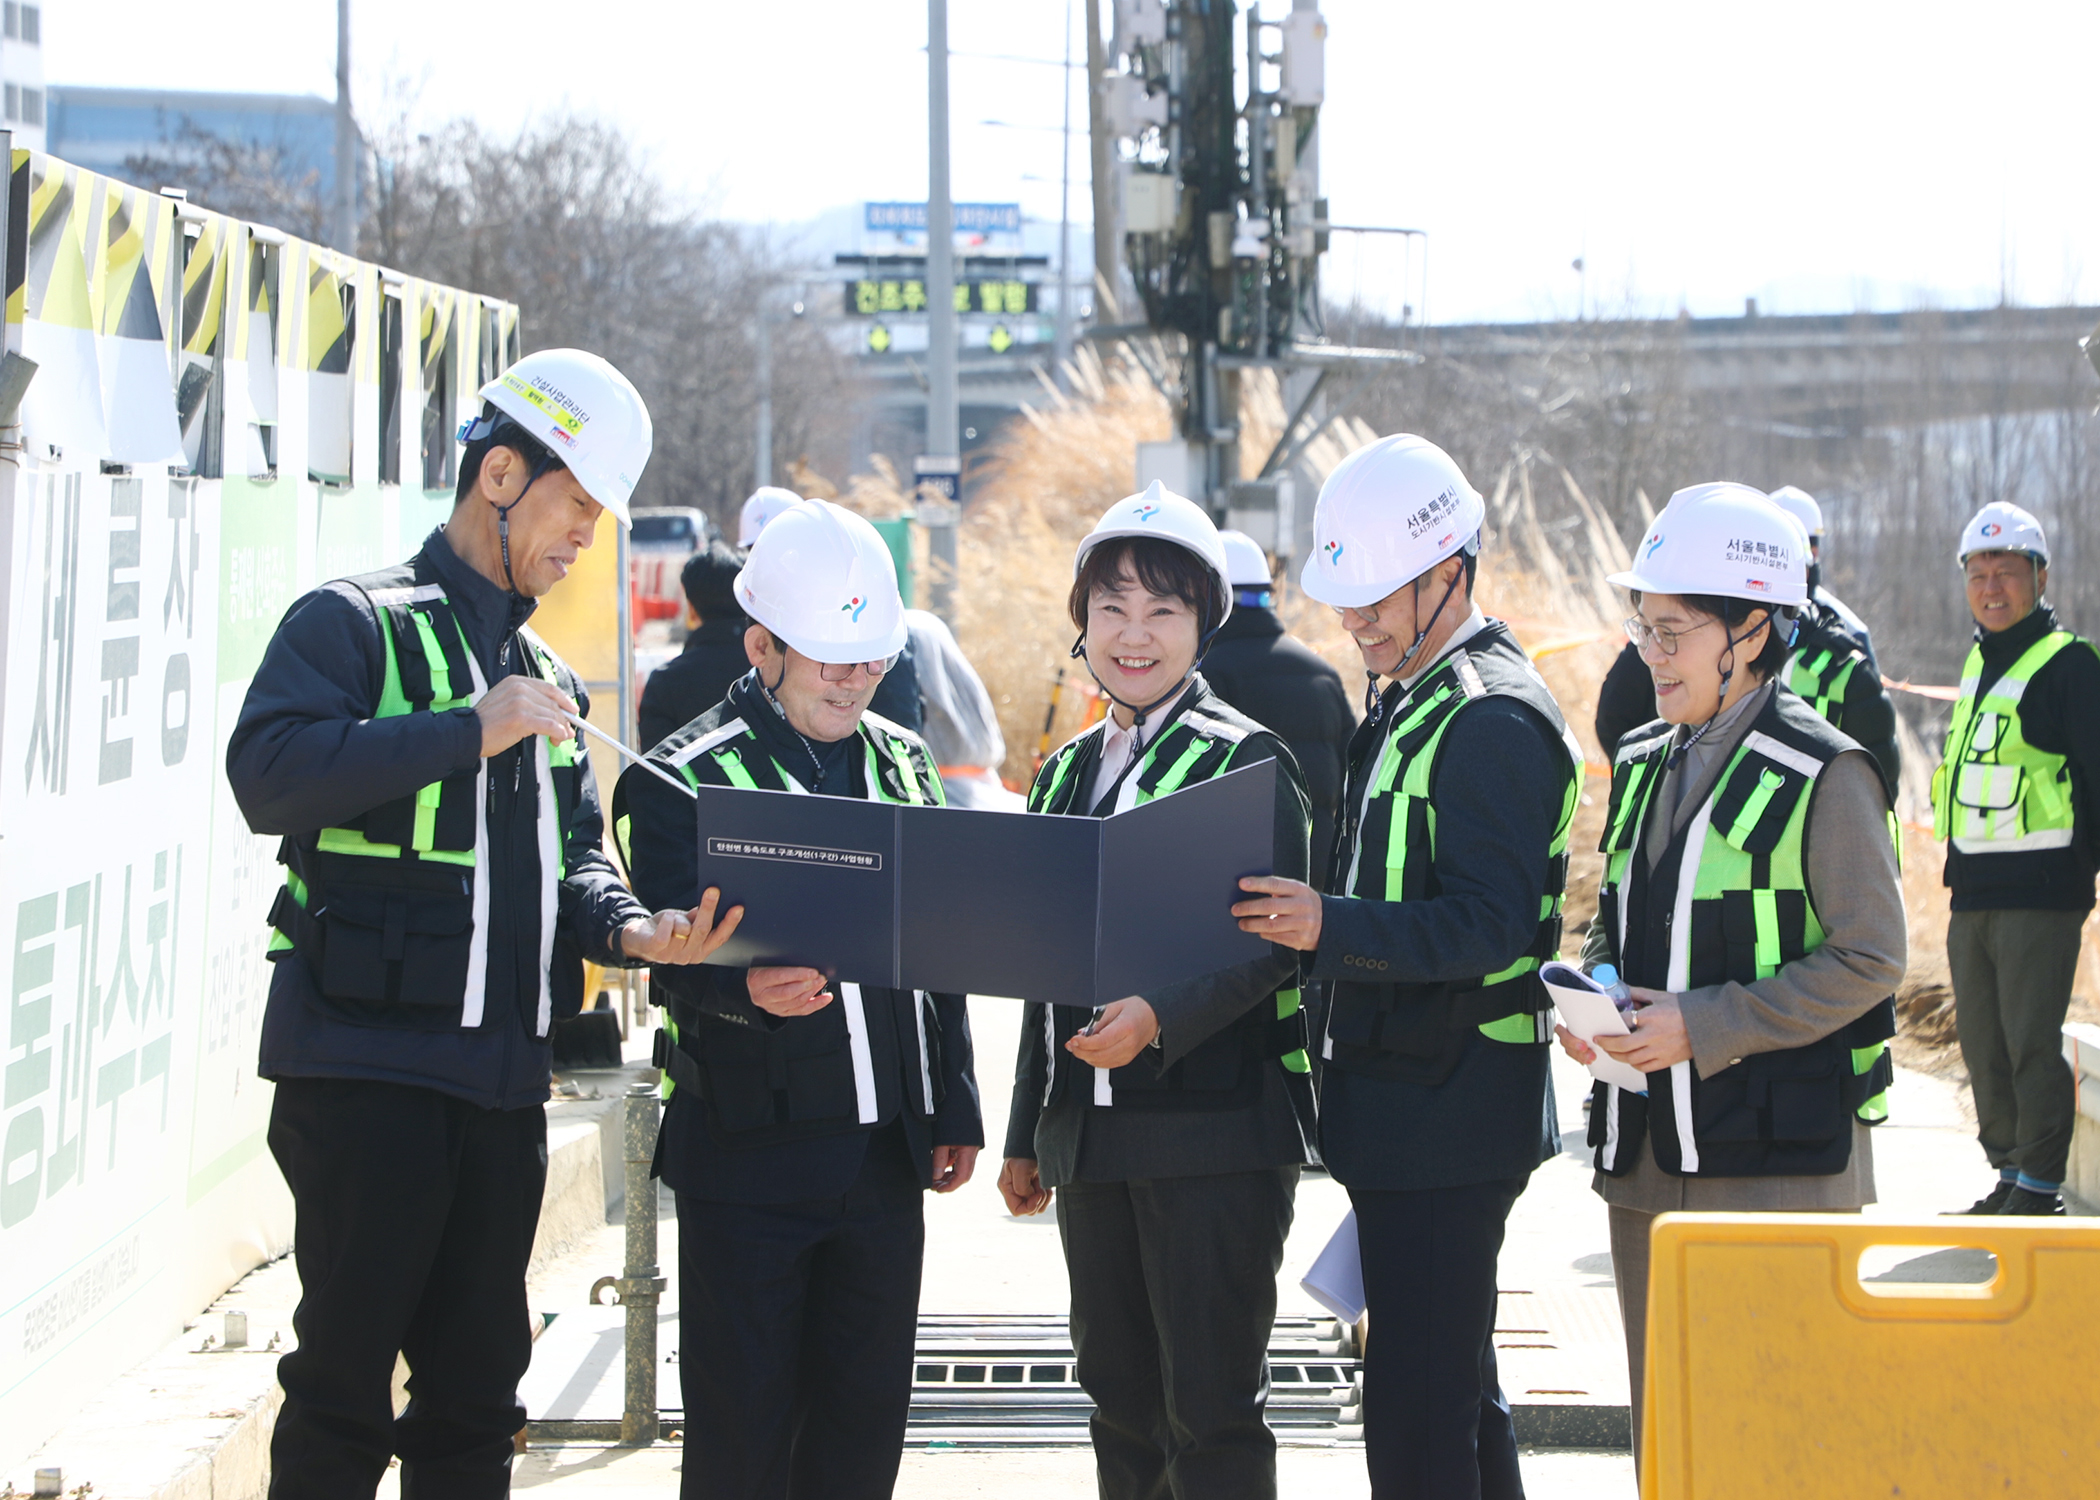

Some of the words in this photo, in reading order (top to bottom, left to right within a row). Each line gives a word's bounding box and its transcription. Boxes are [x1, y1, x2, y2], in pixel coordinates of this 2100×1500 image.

[856, 280, 971, 314] 건조주보
[531, 375, 591, 424] 건설사업관리단
[1406, 484, 1458, 530] 서울특별시
[1411, 497, 1461, 540] 도시기반시설본부
[1725, 552, 1789, 571] 도시기반시설본부
[1727, 538, 1789, 562] 서울특별시
[24, 471, 200, 798] 세륜장
[716, 842, 742, 853] 탄천변
[743, 844, 776, 855] 동측도로
[778, 847, 839, 862] 구조개선(1구간)
[840, 855, 873, 866] 사업현황
[0, 843, 183, 1229] 통과수칙
